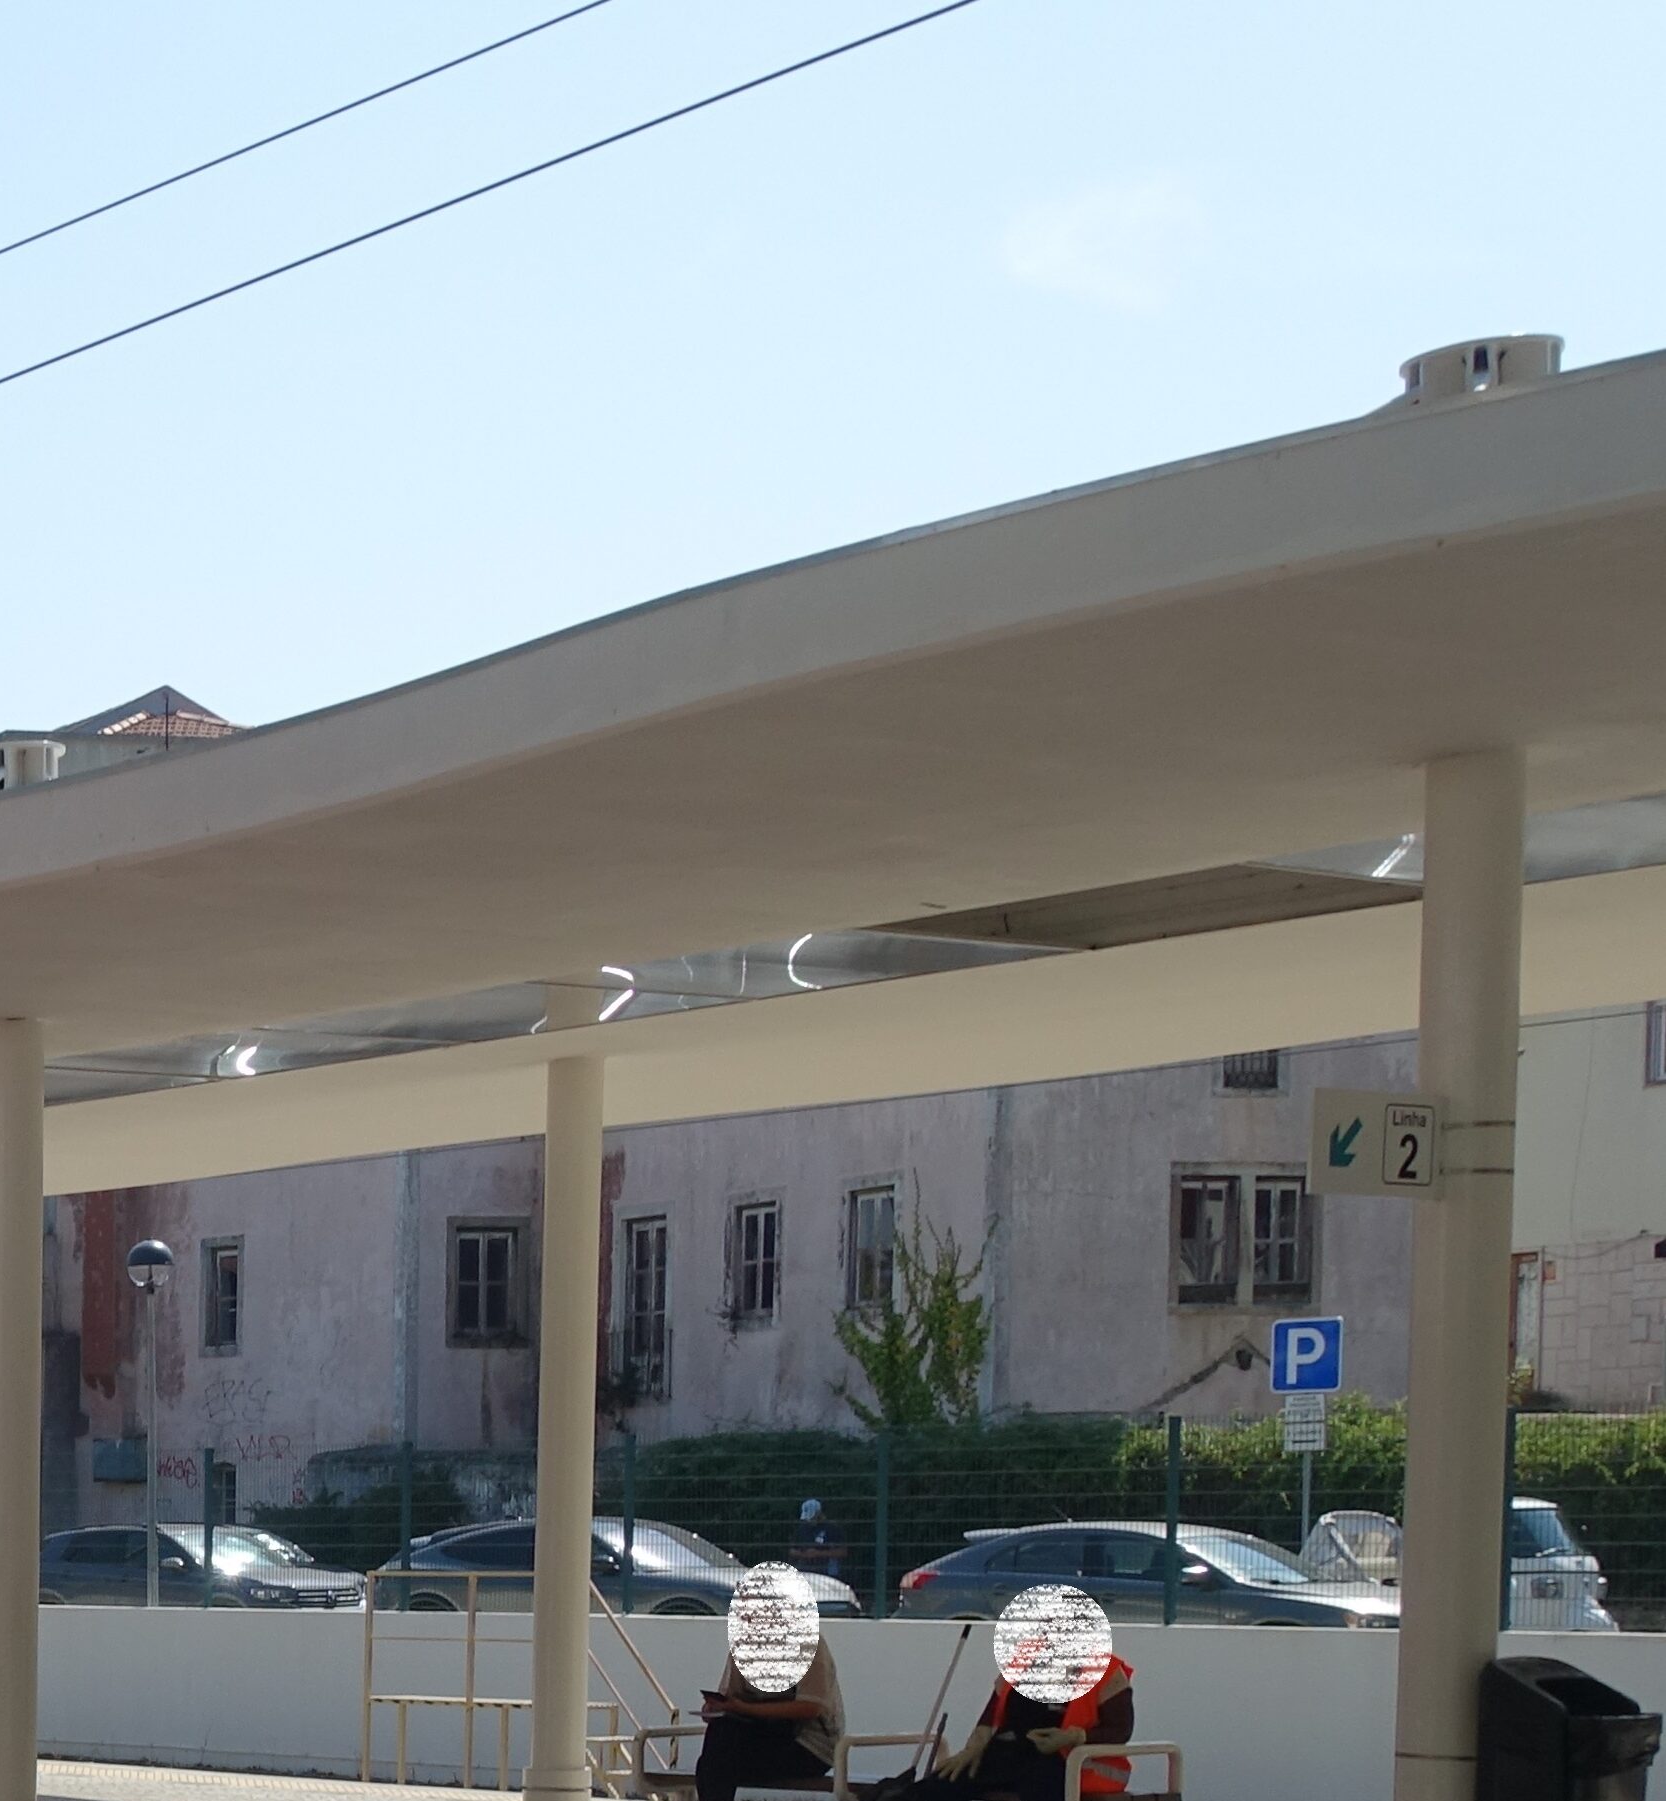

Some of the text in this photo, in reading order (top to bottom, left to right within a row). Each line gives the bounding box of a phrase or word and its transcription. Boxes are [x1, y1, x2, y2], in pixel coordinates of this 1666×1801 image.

[1391, 1110, 1428, 1128] Linha
[1397, 1133, 1419, 1180] 2
[1285, 1326, 1327, 1385] P
